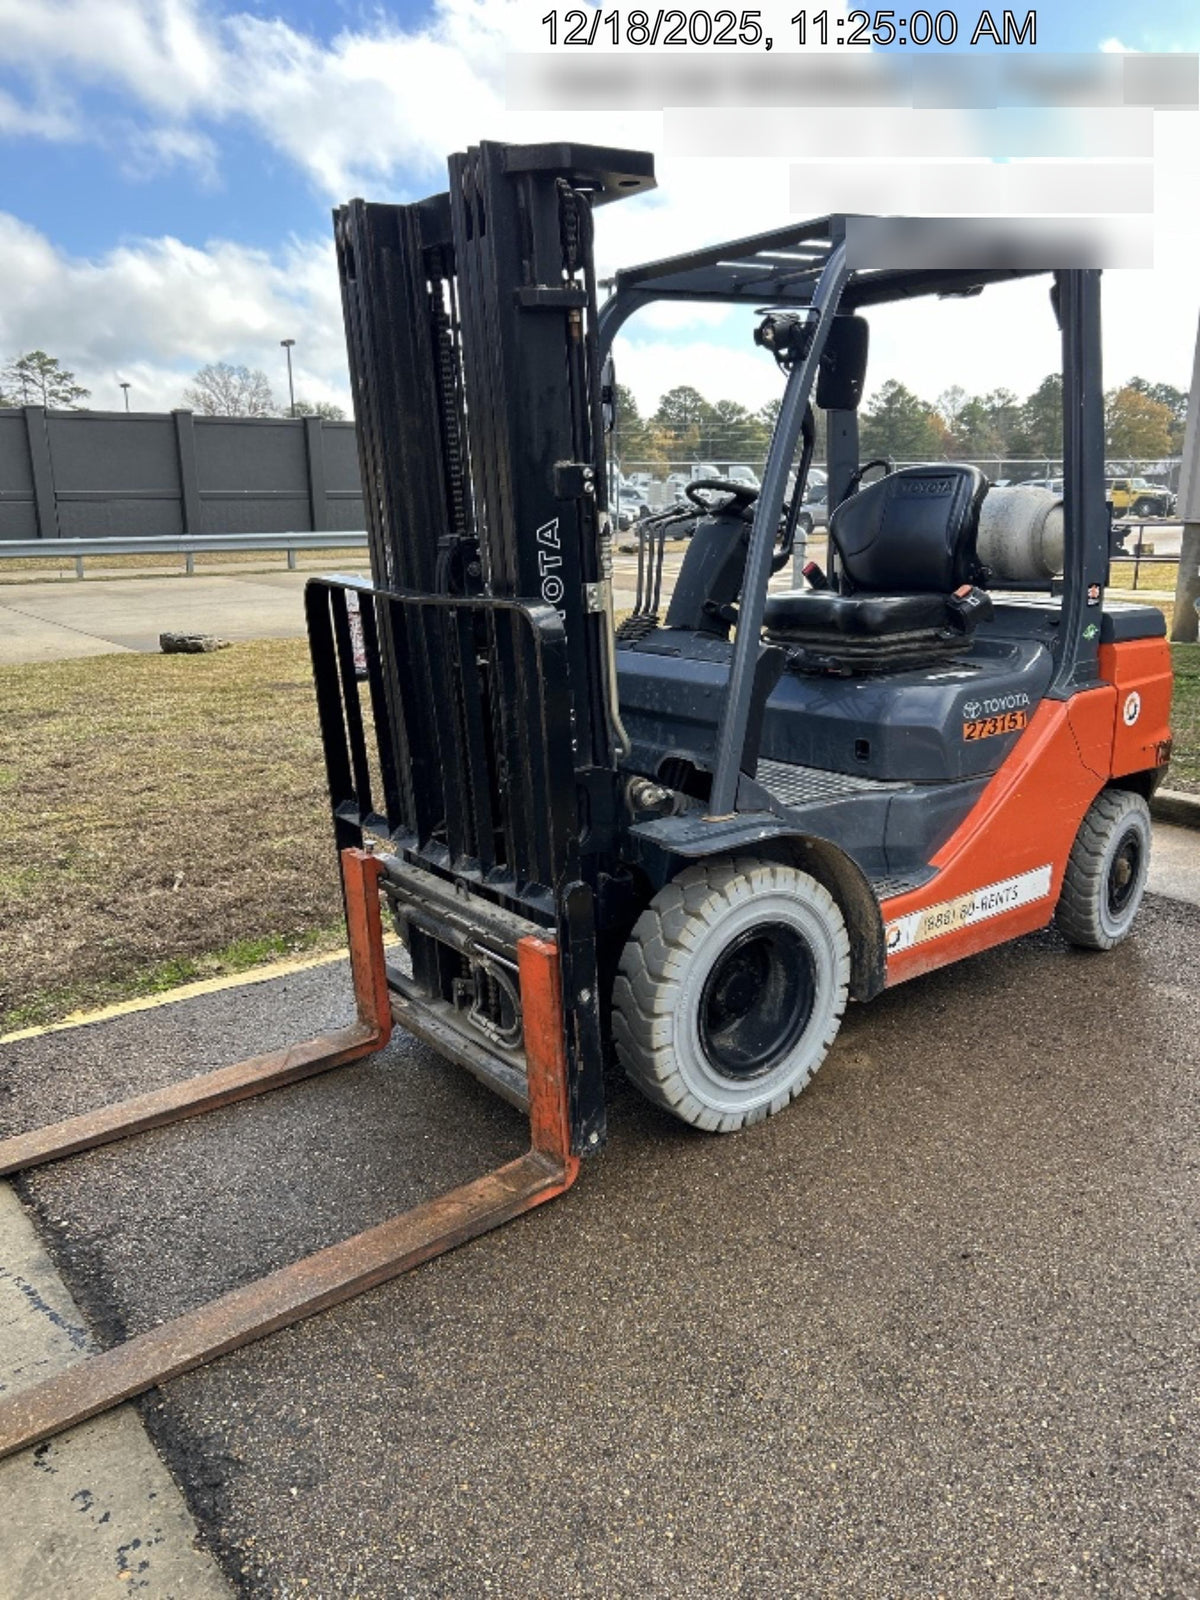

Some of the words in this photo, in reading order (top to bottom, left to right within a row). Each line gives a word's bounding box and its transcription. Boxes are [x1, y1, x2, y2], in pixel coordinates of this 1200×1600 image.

[536, 517, 566, 620] OTA
[983, 693, 1030, 714] TOYOTA
[965, 712, 1025, 740] 273151
